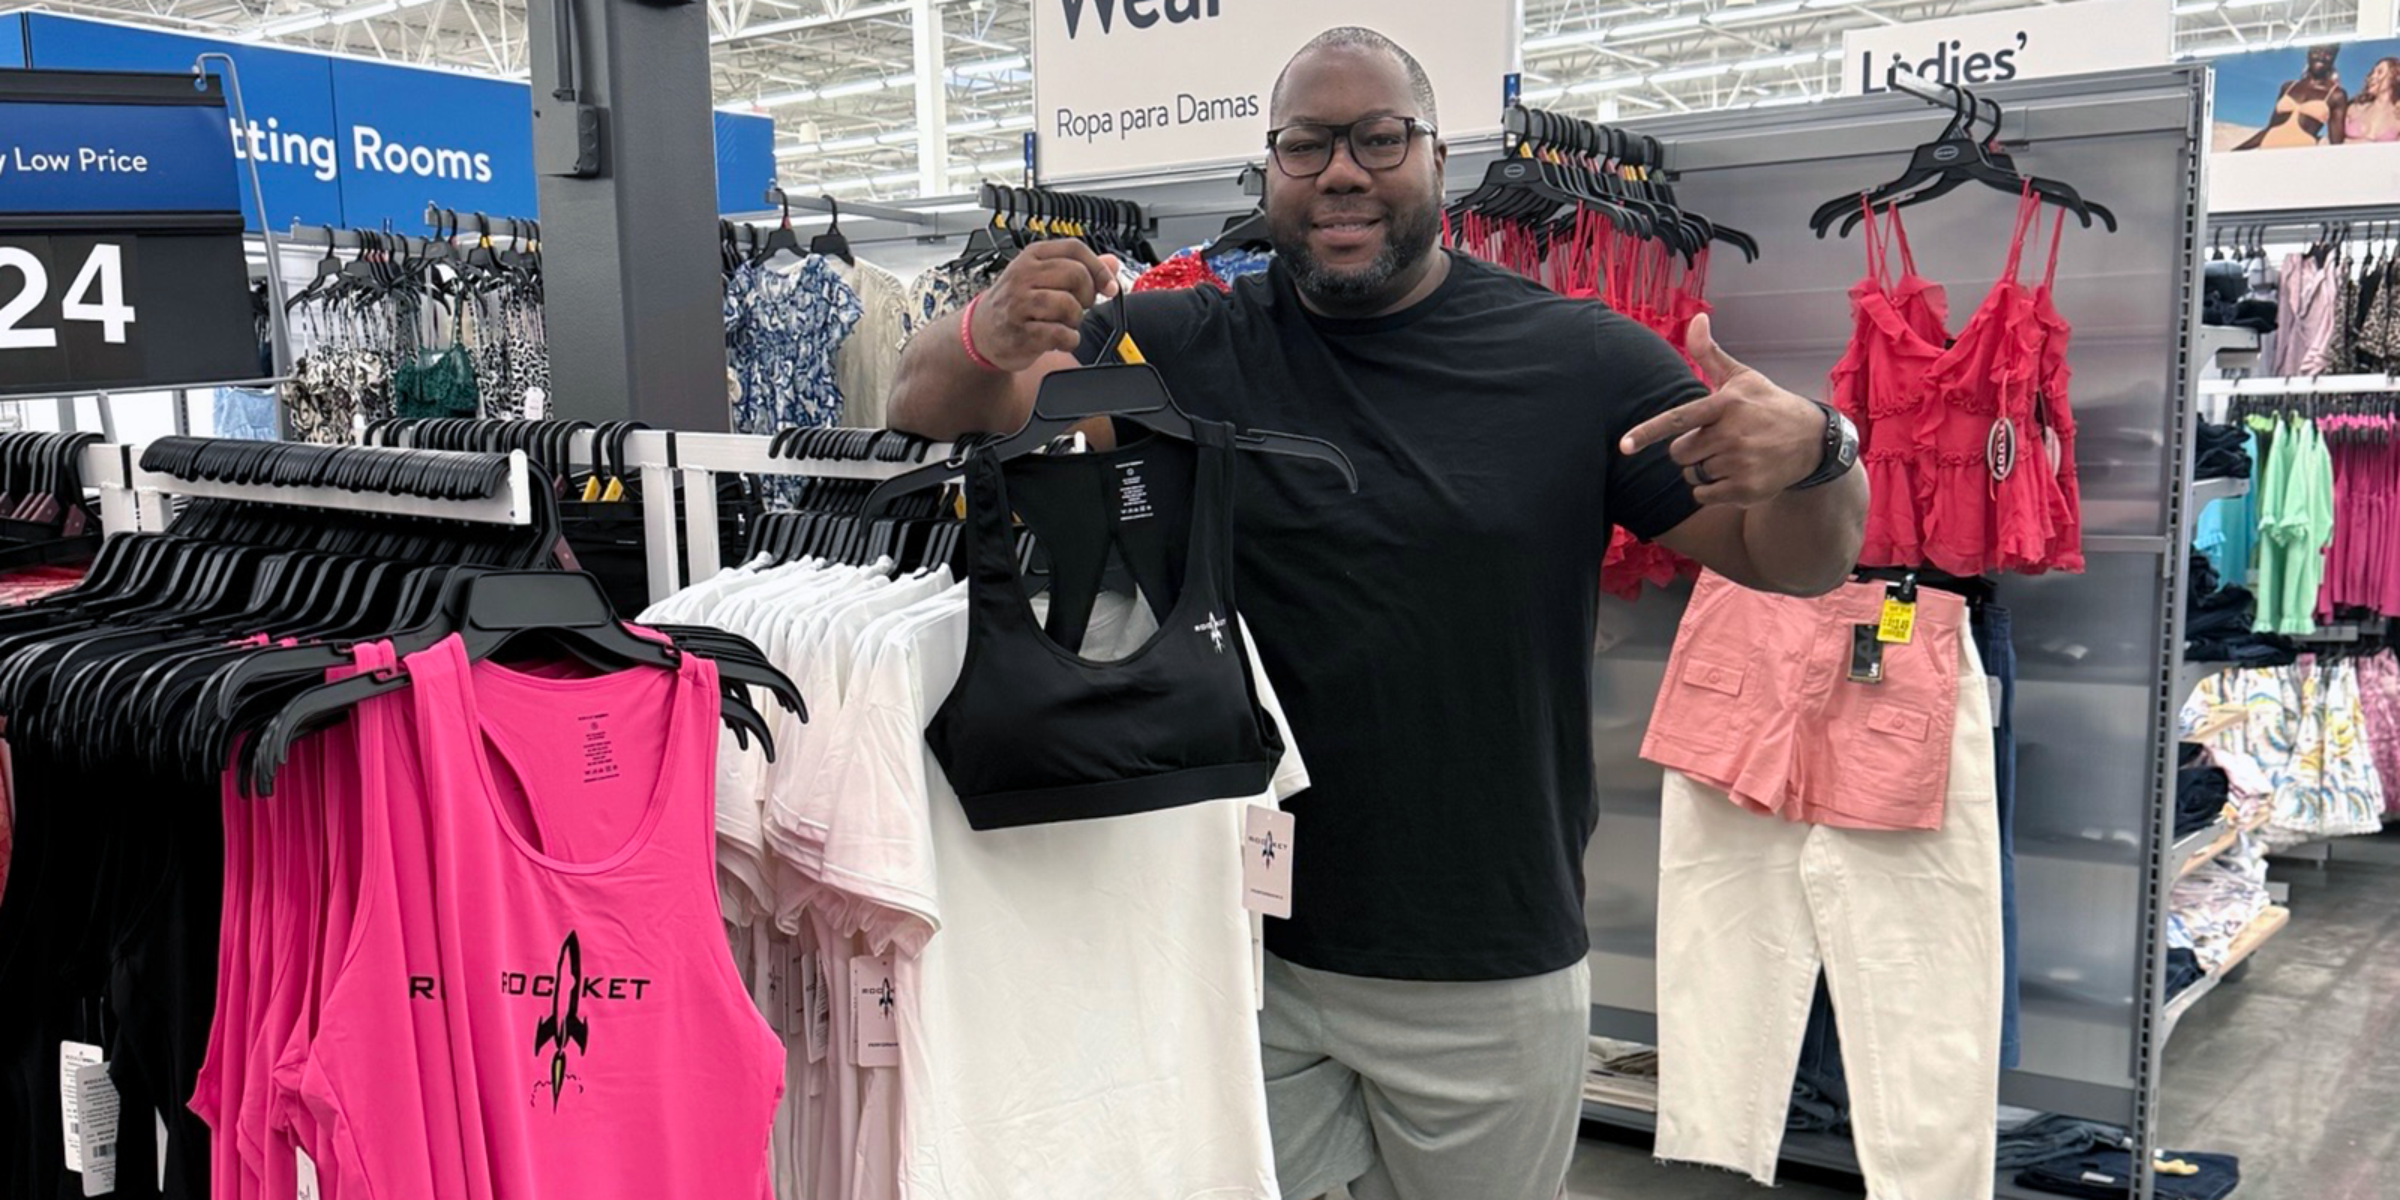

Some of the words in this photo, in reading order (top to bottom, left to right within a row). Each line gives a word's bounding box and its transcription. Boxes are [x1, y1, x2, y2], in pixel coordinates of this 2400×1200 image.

[1057, 108, 1113, 144] Ropa
[1120, 105, 1169, 140] para
[1177, 93, 1259, 125] Damas
[15, 147, 70, 171] Low
[79, 147, 148, 172] Price
[353, 125, 492, 183] Rooms
